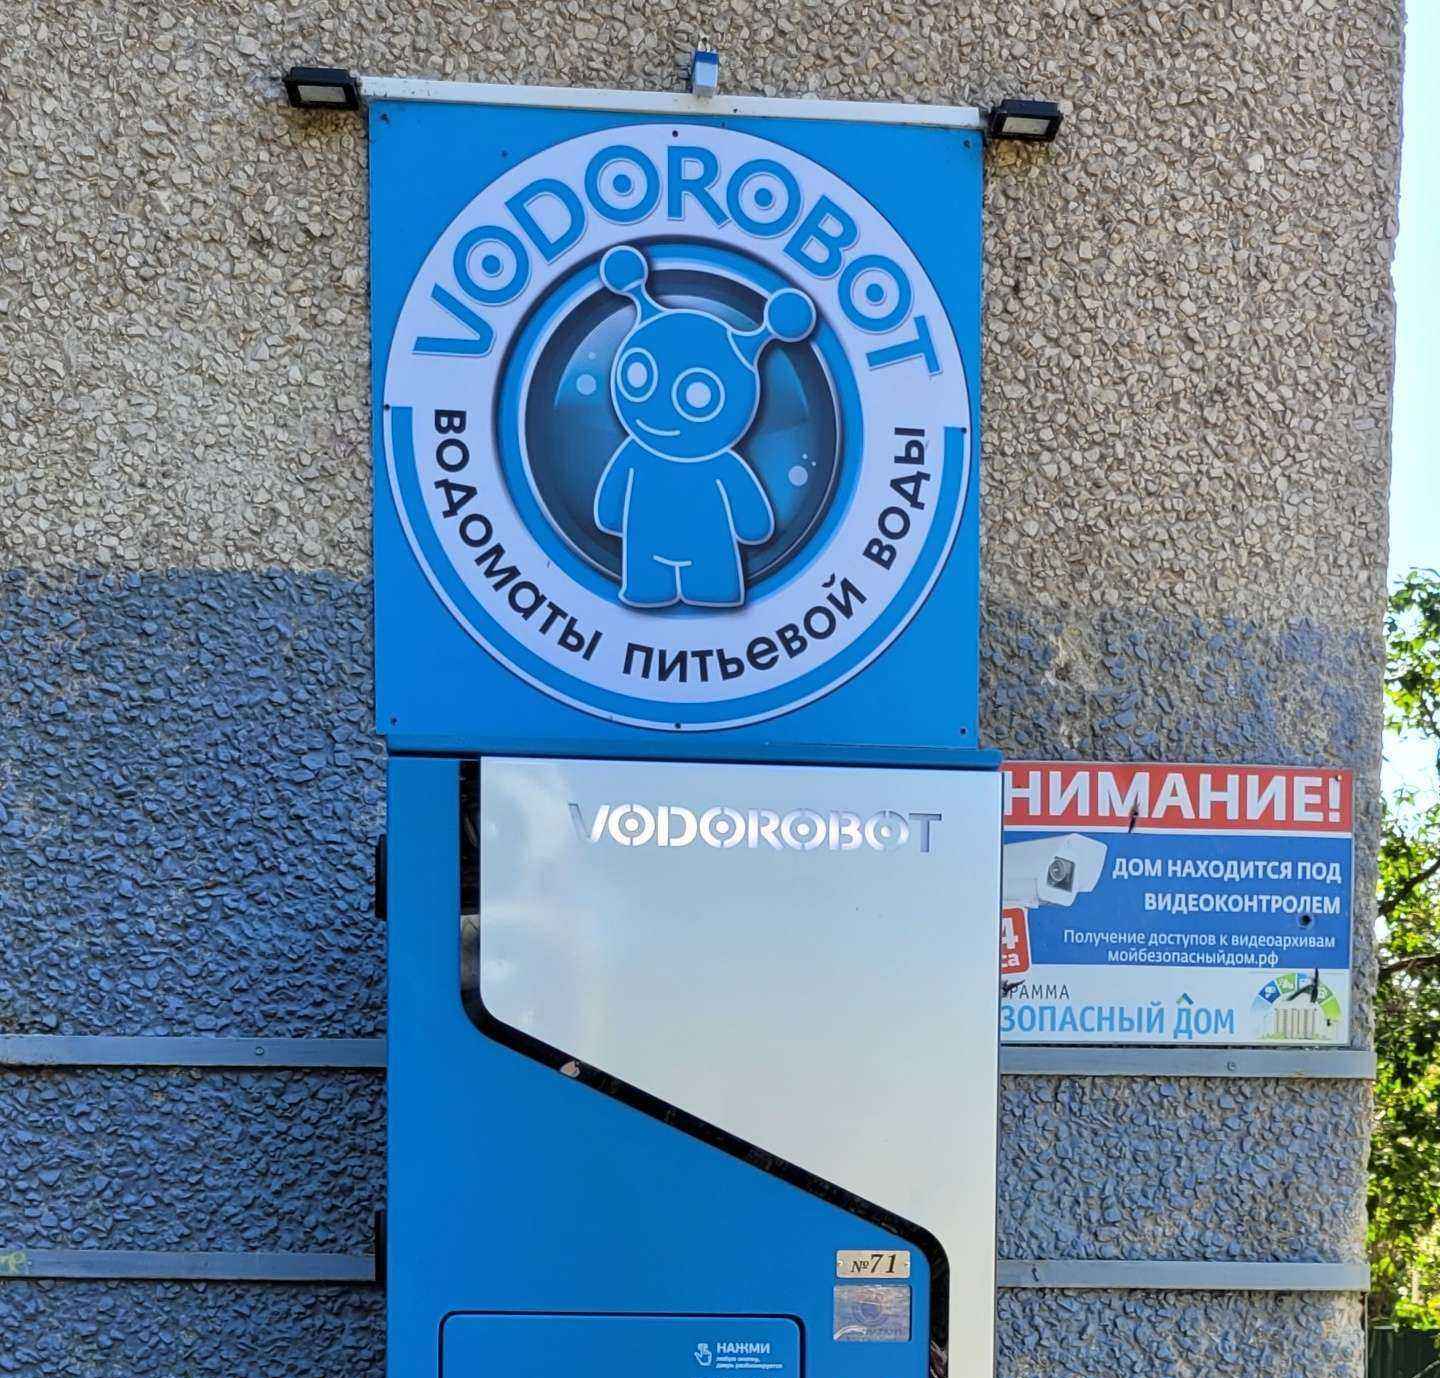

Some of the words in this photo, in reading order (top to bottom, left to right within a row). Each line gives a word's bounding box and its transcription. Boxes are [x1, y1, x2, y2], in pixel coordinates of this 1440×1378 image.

[412, 145, 943, 377] VODOROBOT
[568, 803, 943, 853] VODOROBOT
[1113, 858, 1162, 879] ДОМ
[1167, 859, 1293, 882] НАХОДИТСЯ
[1297, 862, 1342, 884] ПОД
[1144, 893, 1341, 914] ВИДЕОКОНТРОЛЕМ
[1064, 929, 1145, 947] Получение
[1148, 932, 1216, 948] доступов
[1220, 935, 1228, 946] к
[1231, 934, 1336, 949] видеоархивам
[1108, 949, 1279, 967] мойбезопасныйдом.рф
[1173, 1004, 1234, 1039] ДОМ
[717, 1343, 770, 1354] НАЖМИ
